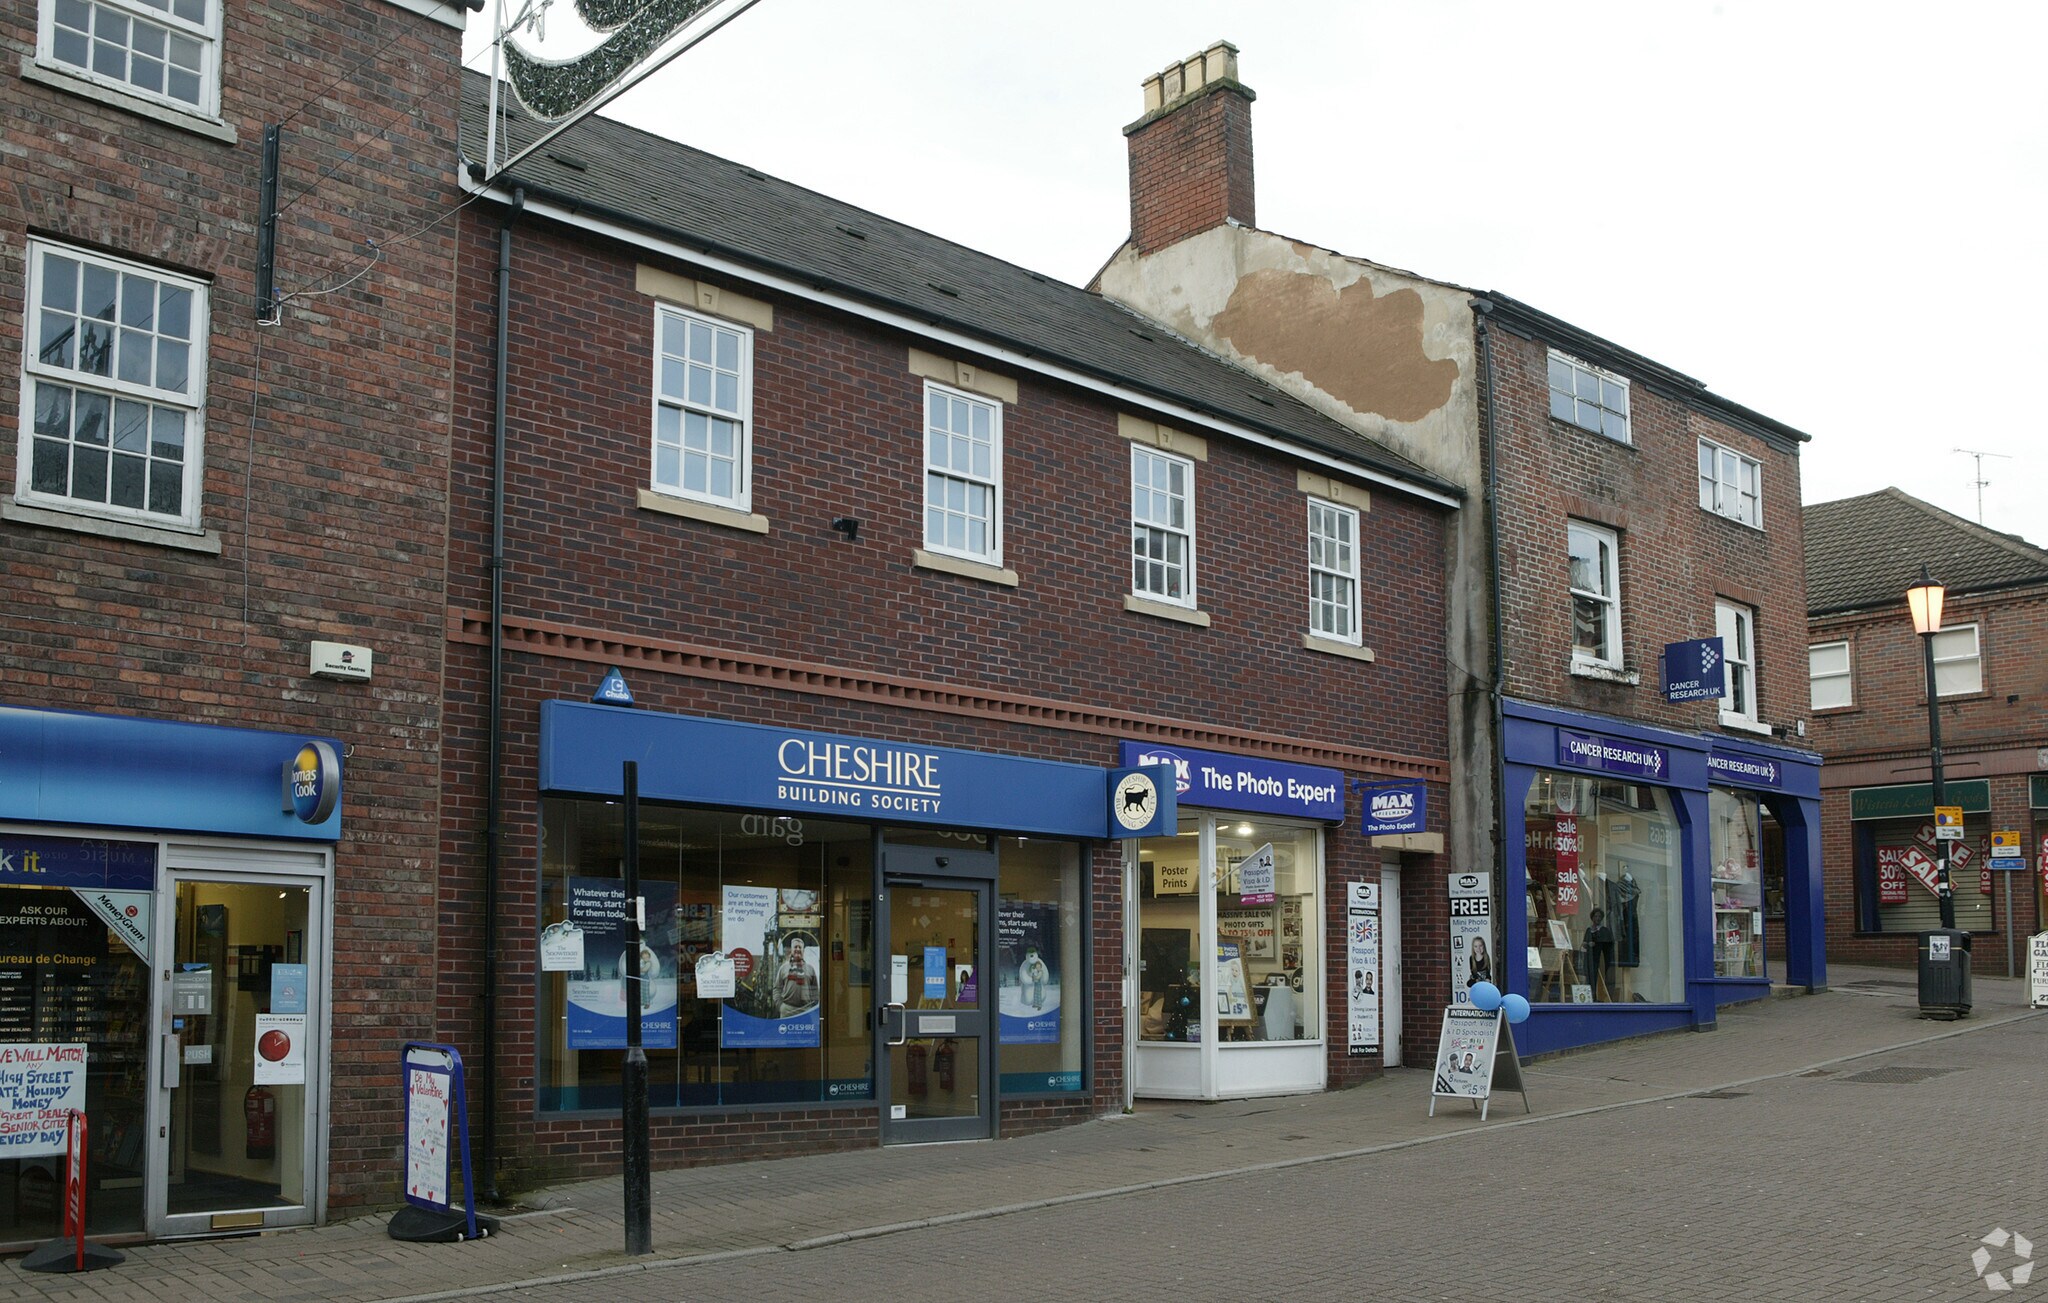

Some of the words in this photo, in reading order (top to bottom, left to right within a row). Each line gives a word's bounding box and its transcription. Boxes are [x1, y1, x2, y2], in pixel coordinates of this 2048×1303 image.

[325, 662, 347, 671] Security
[1669, 680, 1700, 691] CANCER
[1670, 688, 1709, 700] RESEARCH
[1709, 686, 1721, 695] UK
[1570, 741, 1602, 758] CANCER
[1603, 746, 1642, 765] RESEARCH
[1643, 754, 1654, 767] UK
[778, 738, 942, 789] CHESHIRE
[1728, 758, 1760, 776] RESEARCH
[1760, 765, 1770, 777] UK
[295, 781, 317, 797] Cook
[1120, 774, 1150, 791] CHESHIRE
[1201, 766, 1233, 791] The
[1237, 771, 1283, 797] Photo
[1287, 778, 1336, 806] Expert
[778, 785, 861, 806] BUILDING
[871, 794, 941, 814] SOCIETY
[1372, 793, 1414, 810] MAX
[1115, 797, 1137, 828] BUILDING
[1139, 794, 1156, 828] SOCIETY
[1367, 824, 1379, 832] The
[1379, 823, 1396, 831] Photo
[1396, 822, 1416, 831] Expert
[1557, 818, 1577, 834] sale
[1556, 836, 1578, 853] 50%
[23, 849, 47, 873] it.
[1161, 866, 1189, 876] Poster
[1557, 868, 1578, 884] sale
[1880, 864, 1906, 880] 50%
[1901, 850, 1941, 897] SAL
[1163, 878, 1188, 888] Prints
[1880, 881, 1906, 890] OFF
[573, 887, 610, 898] Whatever
[611, 889, 626, 899] thei
[1557, 887, 1578, 902] 50%
[573, 898, 603, 909] dreams,
[603, 901, 622, 909] start
[1451, 898, 1489, 916] FREE
[20, 906, 42, 915] ASK
[44, 906, 68, 915] OUR
[573, 907, 584, 917] for
[585, 908, 606, 918] them
[735, 908, 764, 917] everything
[1217, 911, 1244, 919] MASSIVE
[1351, 908, 1377, 916] INTERNATIONAL
[0, 916, 47, 926] EXPERTS
[49, 917, 88, 927] ABOUT:
[97, 894, 146, 942] MoneyGram
[1007, 919, 1021, 927] start
[1021, 920, 1038, 929] saving
[1247, 920, 1265, 928] GIFTS
[1452, 918, 1467, 926] Mini
[1467, 918, 1488, 926] Photo
[1010, 928, 1026, 937] today
[1228, 929, 1239, 937] TO
[1725, 932, 1740, 947] sale
[0, 955, 32, 964] ureau
[35, 954, 51, 964] de
[53, 954, 97, 967] Change
[1351, 956, 1363, 964] Visa
[1454, 991, 1467, 1004] 10
[1450, 1009, 1496, 1018] INTERNATIONAL
[641, 1021, 672, 1030] CHESHIRE
[787, 1023, 815, 1031] CHESHIRE
[1462, 1029, 1495, 1037] Specialists
[14, 1047, 45, 1063] WILL
[46, 1045, 85, 1064] MATCH
[185, 1049, 212, 1060] PUSH
[26, 1062, 44, 1070] ANY
[26, 1069, 74, 1085] STREET
[1448, 1073, 1454, 1083] 8
[0, 1086, 20, 1098] ATE
[25, 1085, 71, 1100] HOLIDAY
[415, 1083, 443, 1100] Valentine
[838, 1082, 869, 1091] CHESHIRE
[12, 1097, 53, 1110] MONEY
[0, 1121, 40, 1134] SENIOR
[0, 1131, 38, 1146] EVERY
[40, 1129, 65, 1146] DAY
